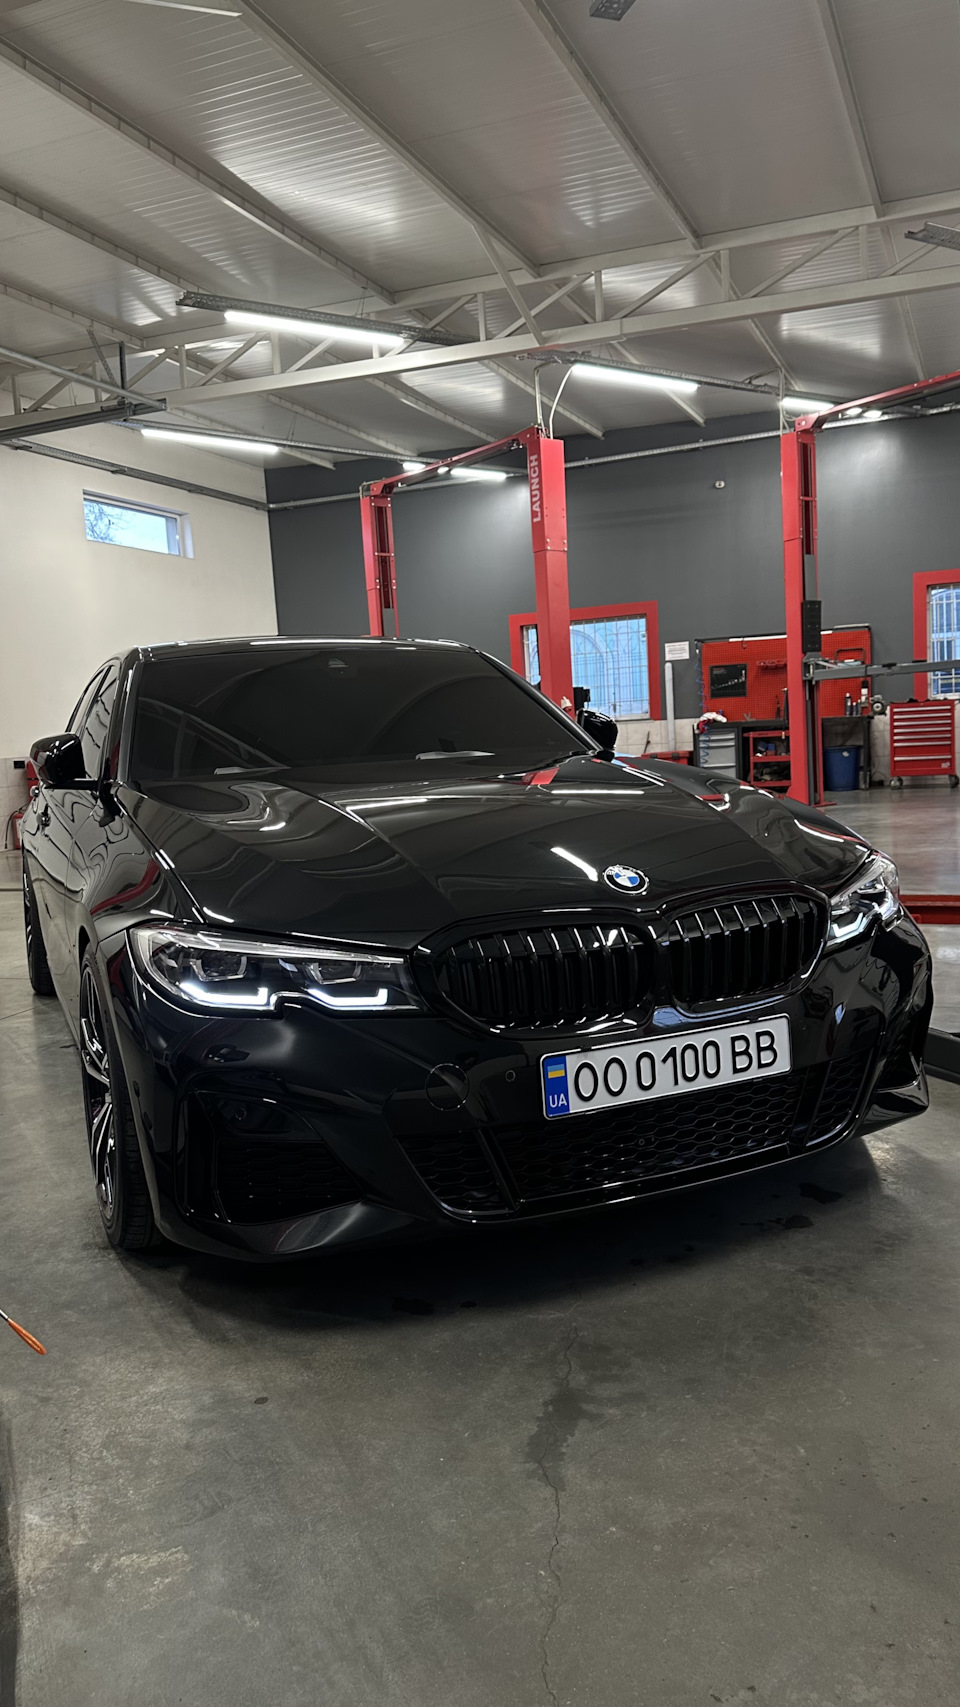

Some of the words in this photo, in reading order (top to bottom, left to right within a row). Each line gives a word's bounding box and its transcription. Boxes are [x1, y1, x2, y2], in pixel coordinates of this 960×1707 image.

[530, 454, 541, 523] LAUNCH
[636, 1040, 721, 1091] 0100
[730, 1030, 778, 1075] BB
[549, 1093, 567, 1108] UA
